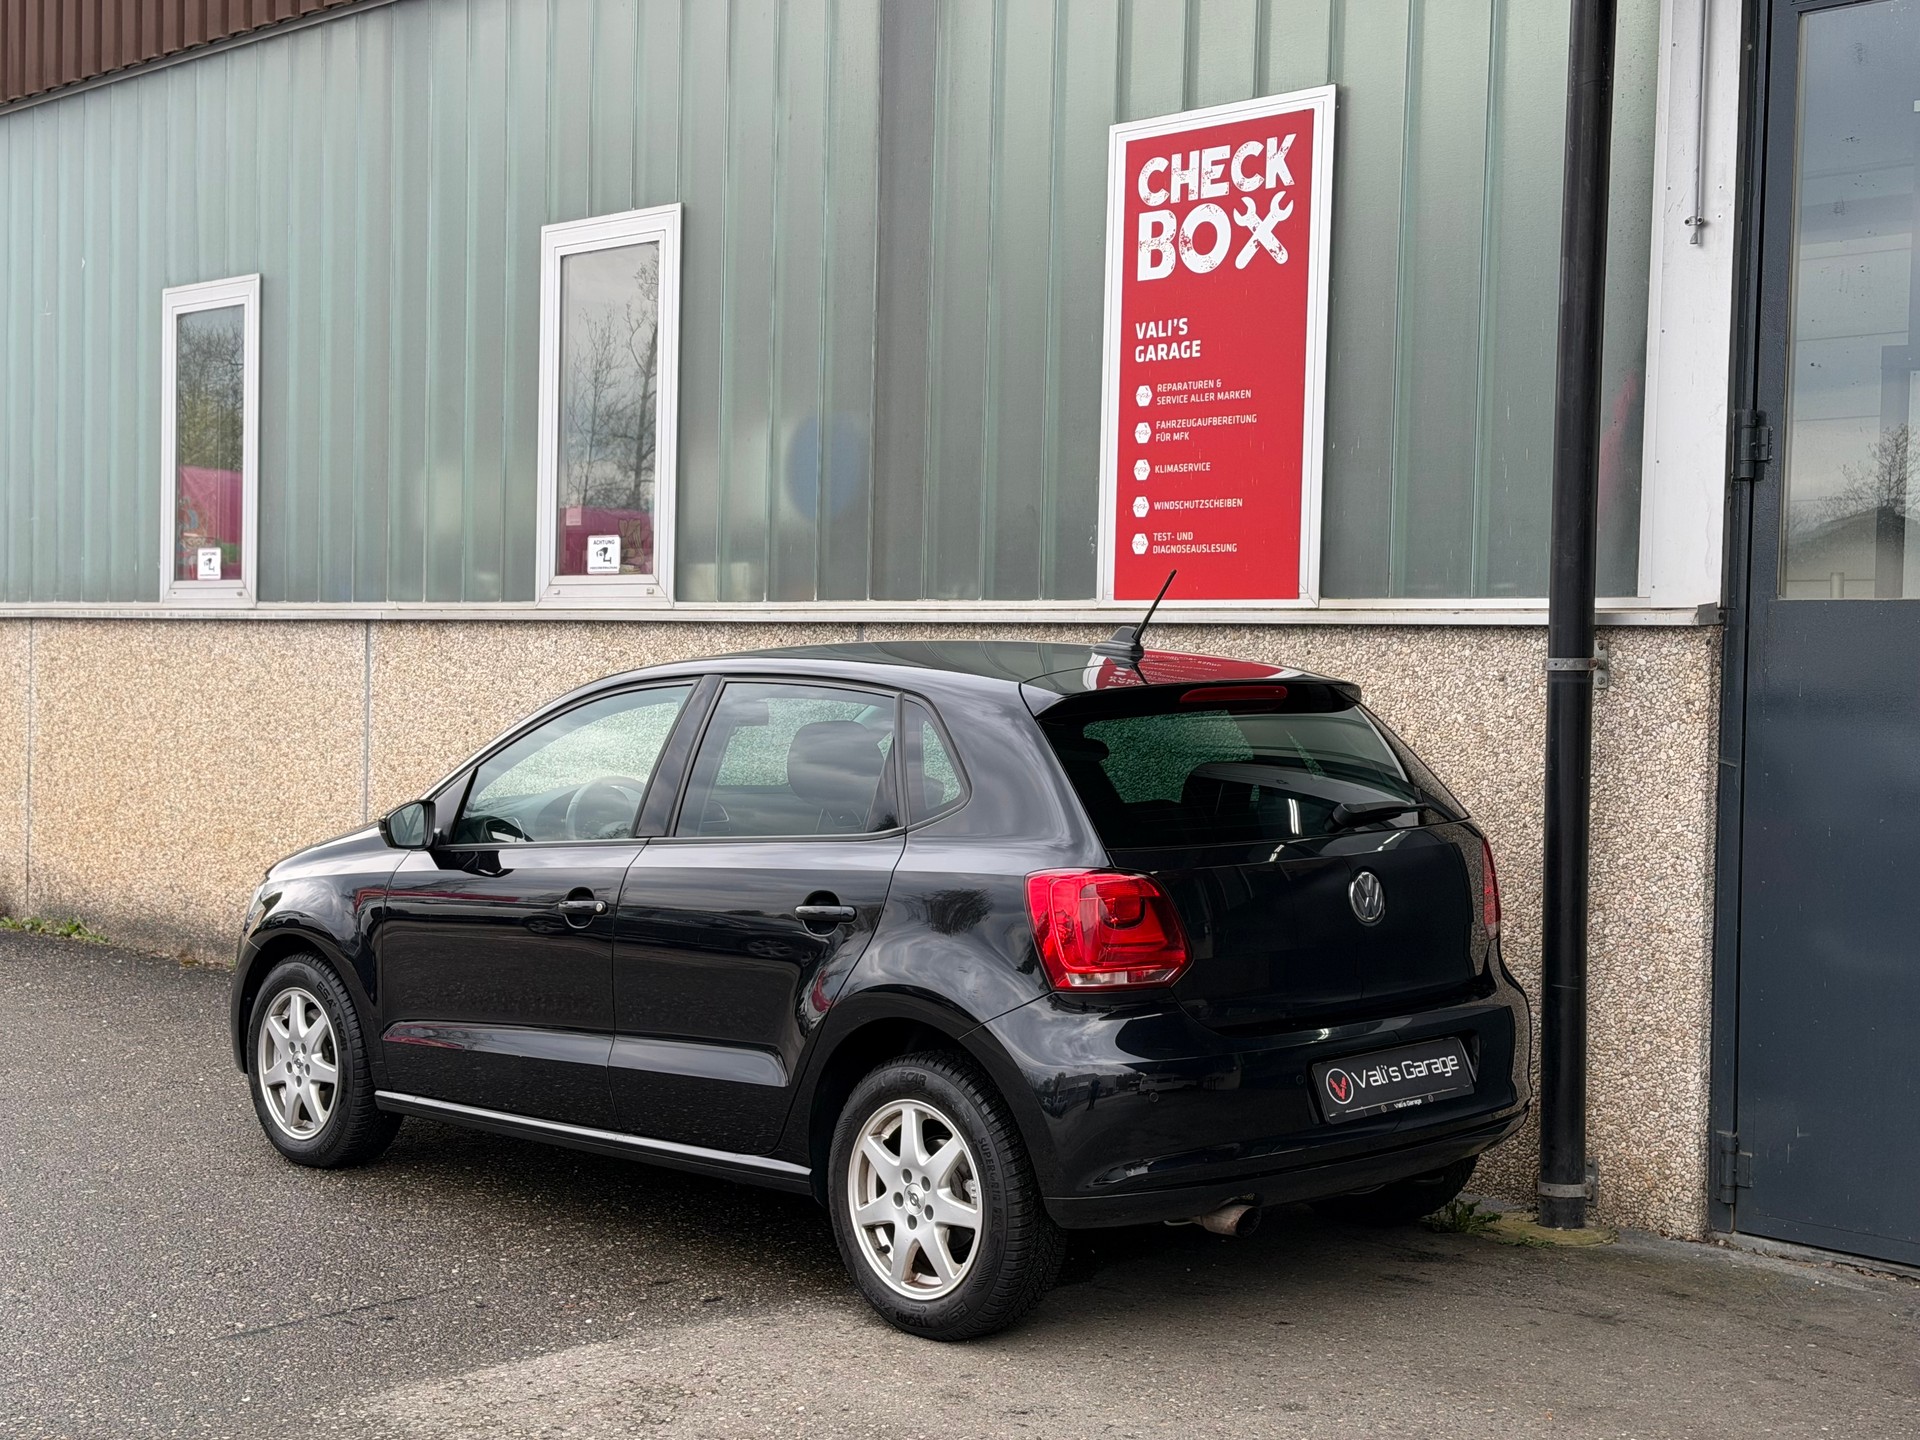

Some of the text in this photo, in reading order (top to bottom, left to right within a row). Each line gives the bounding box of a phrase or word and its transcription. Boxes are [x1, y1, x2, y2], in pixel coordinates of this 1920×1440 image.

[1137, 133, 1297, 207] CHECK
[1137, 190, 1294, 282] BOX
[1135, 317, 1189, 340] VALI'S
[1134, 340, 1202, 363] GARAGE
[1157, 379, 1222, 392] REPARATUREN &
[1156, 389, 1252, 405] SERVICE ALLER MARKEN
[1156, 414, 1257, 429] FAHRZEUGAUFBEREITUNG
[1155, 431, 1190, 443] FÜR MFK
[1154, 462, 1211, 473] KLIMASERVICE
[1153, 498, 1243, 510] WINDSCHUTZSCHEIBEN
[1153, 531, 1194, 541] TEST- UND
[1152, 543, 1238, 554] DIAGNOSEAUSLESUNG
[1351, 1055, 1460, 1089] Vali's Garage
